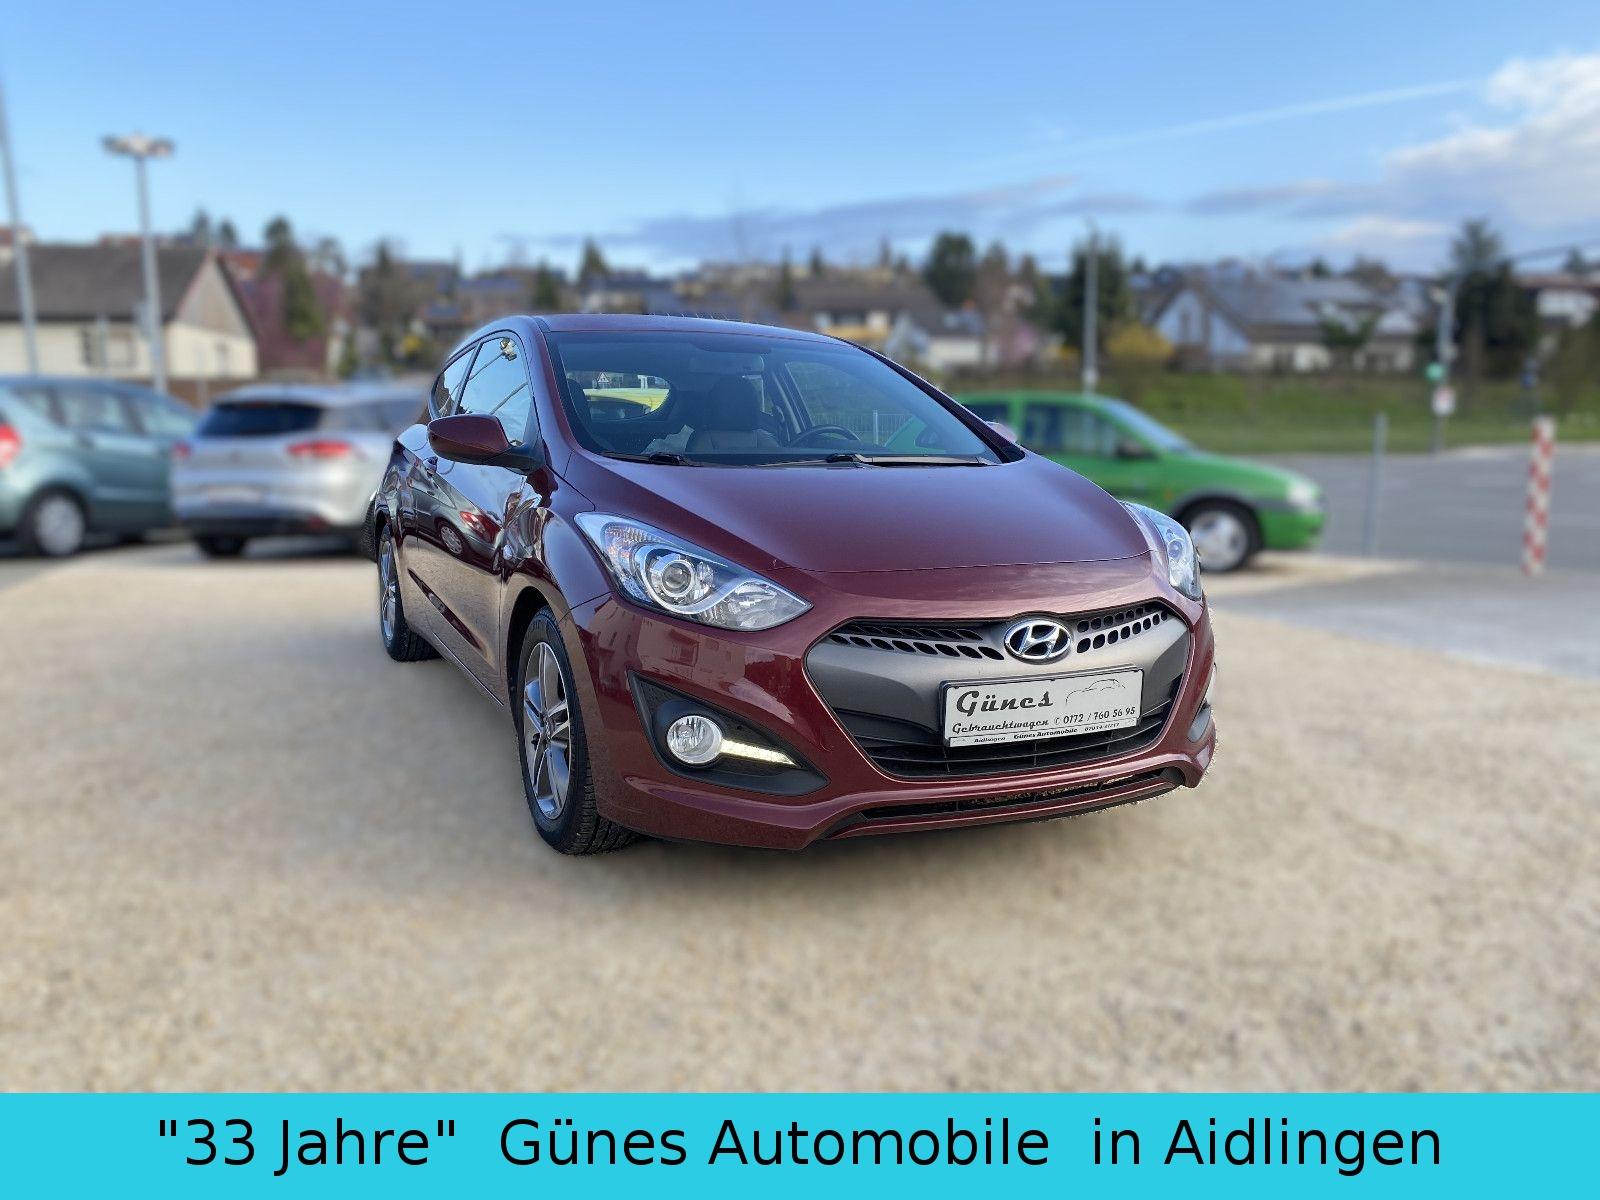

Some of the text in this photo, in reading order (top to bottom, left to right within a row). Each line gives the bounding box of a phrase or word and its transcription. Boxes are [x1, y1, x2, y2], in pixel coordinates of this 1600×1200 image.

[956, 690, 1054, 717] Günes
[952, 719, 1049, 734] Gebrauchtwagen
[1063, 713, 1084, 724] 0172
[1094, 711, 1110, 720] 760
[1112, 709, 1123, 718] 56
[1125, 706, 1136, 716] 95
